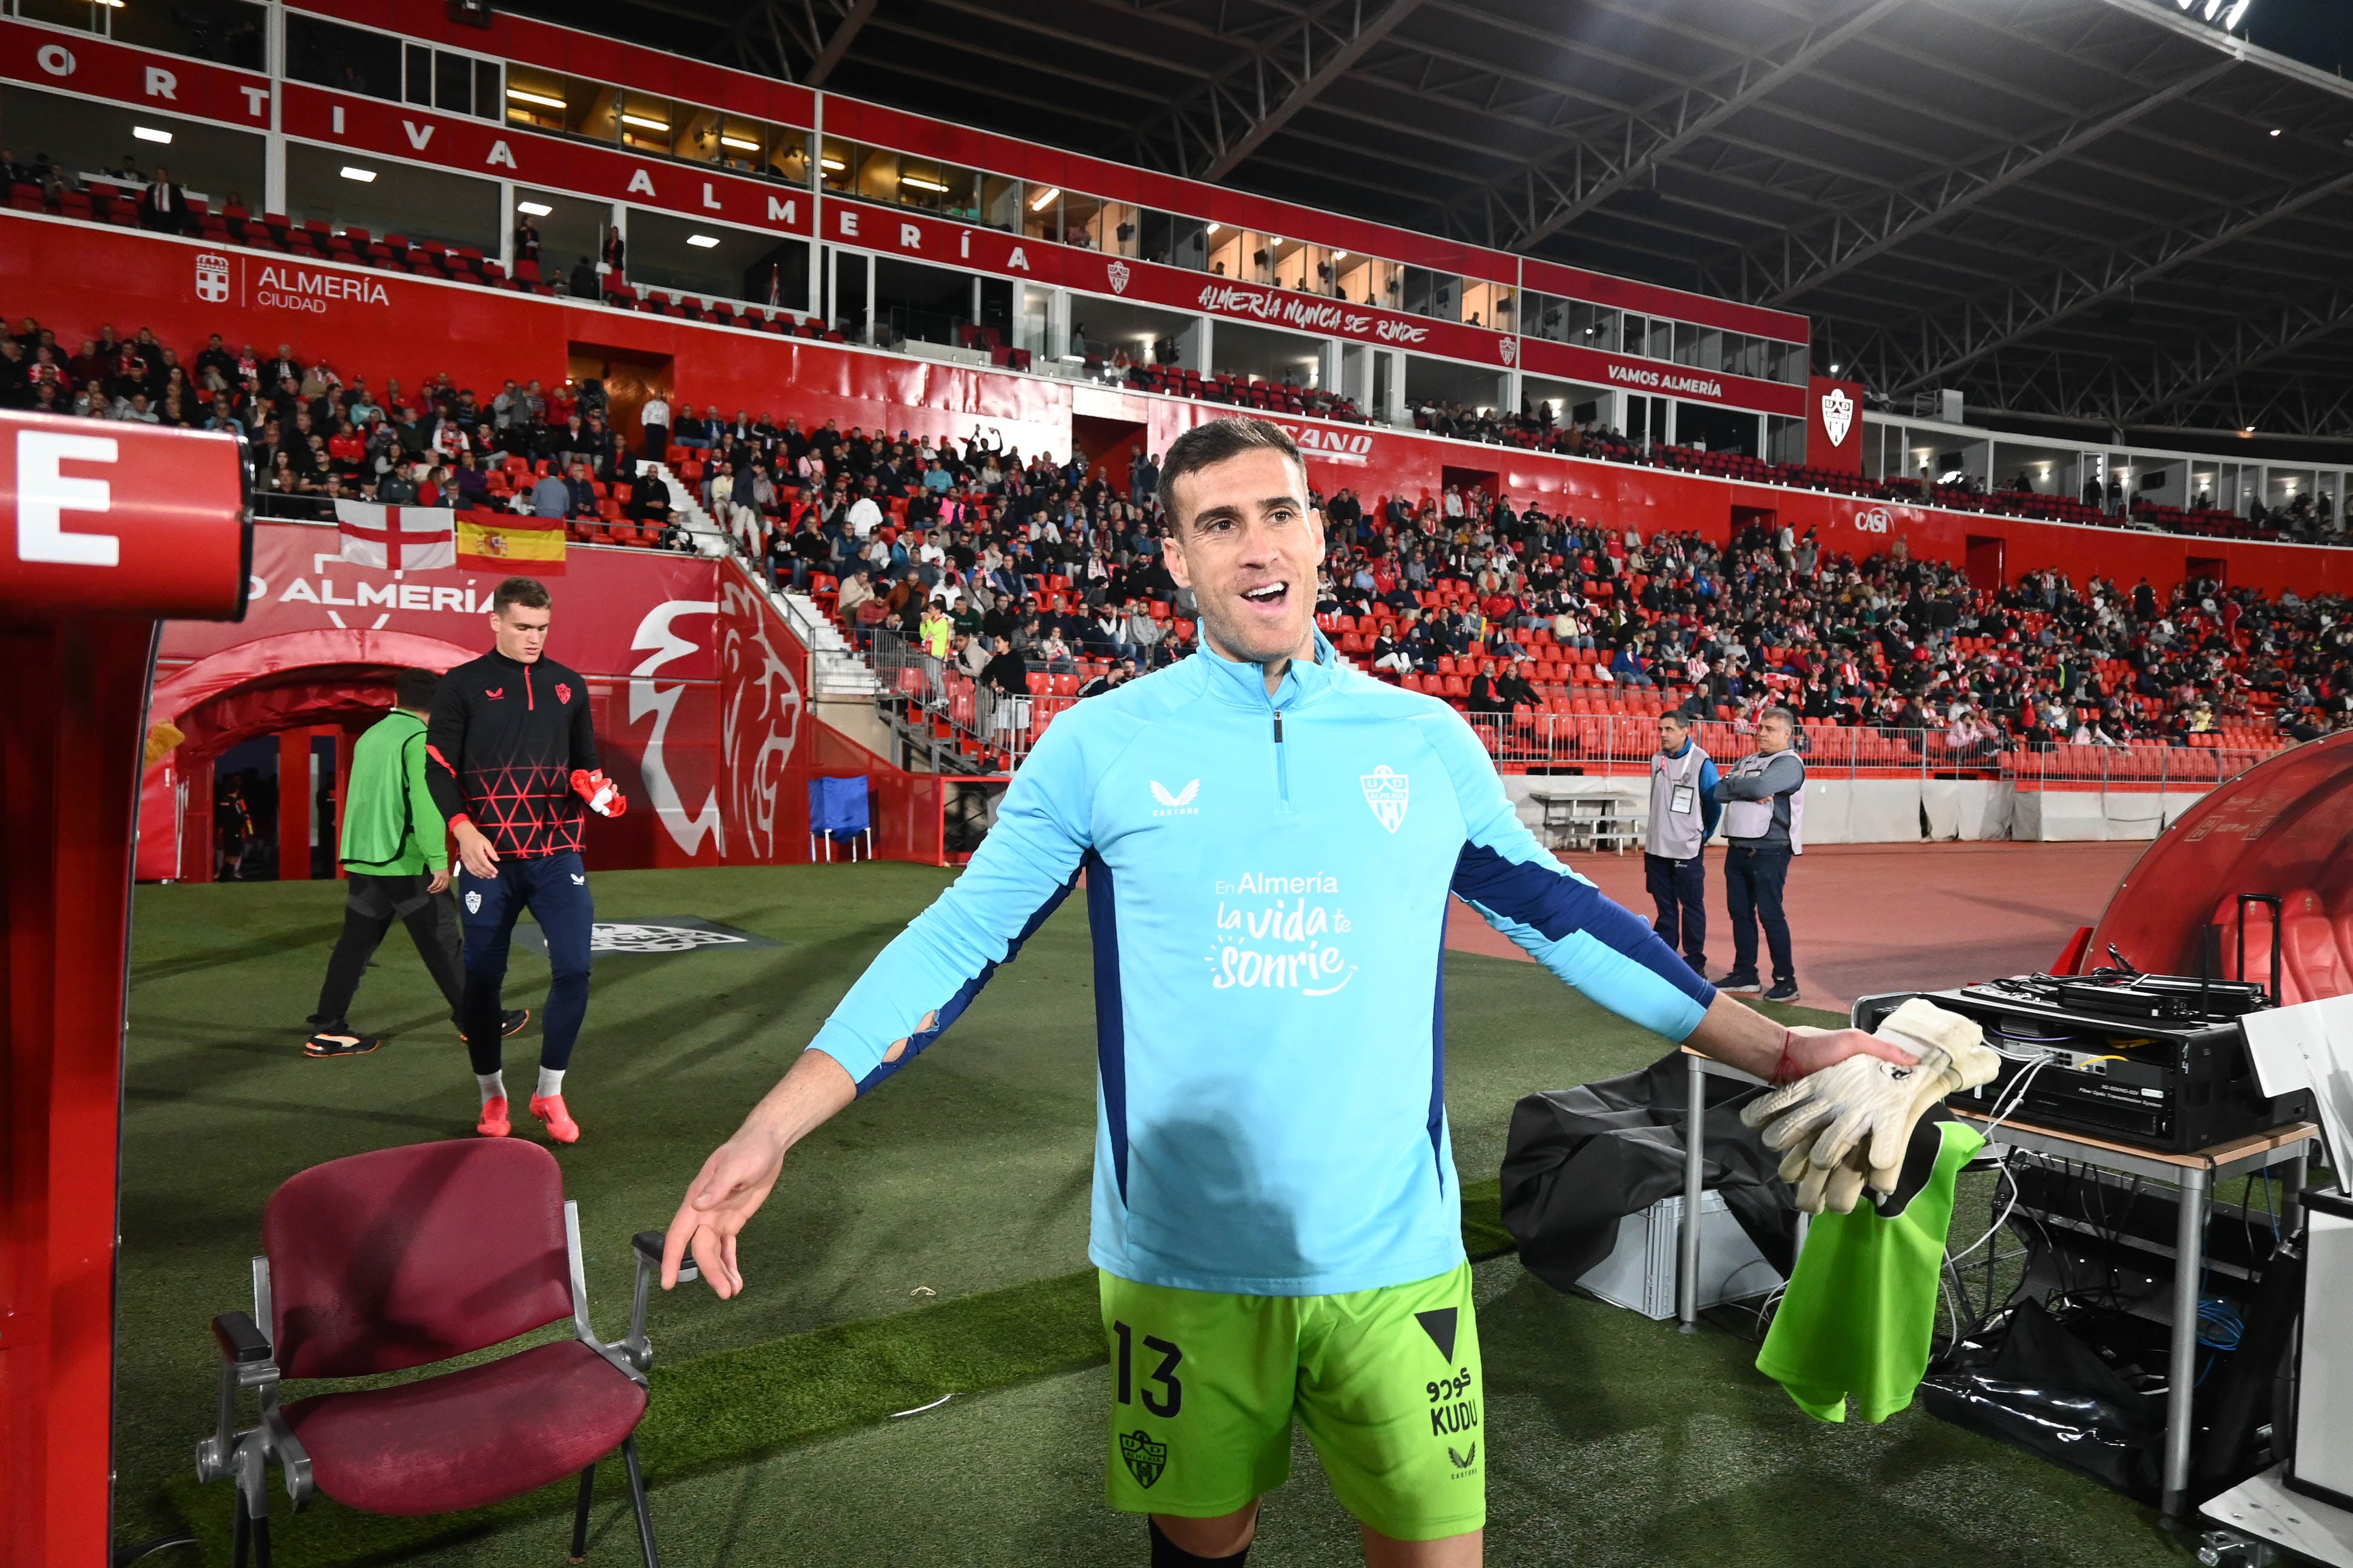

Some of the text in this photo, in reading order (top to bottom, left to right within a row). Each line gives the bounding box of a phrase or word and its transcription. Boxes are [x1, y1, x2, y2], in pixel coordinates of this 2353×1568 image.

[627, 169, 1030, 271] ALMERÍA
[257, 291, 327, 313] CIUDAD
[258, 266, 390, 306] ALMERÍA
[1198, 285, 1429, 342] ALMERÍA NUNCA SE RINDE
[1608, 364, 1722, 397] VAMOS ALMERÍA
[17, 430, 119, 566] E
[1855, 511, 1887, 534] CASI
[1216, 871, 1338, 894] En Almería
[1217, 897, 1352, 942] la vida te
[2142, 1100, 2163, 1108] System
[1113, 1320, 1183, 1418] 13
[1430, 1398, 1478, 1437] KUDU
